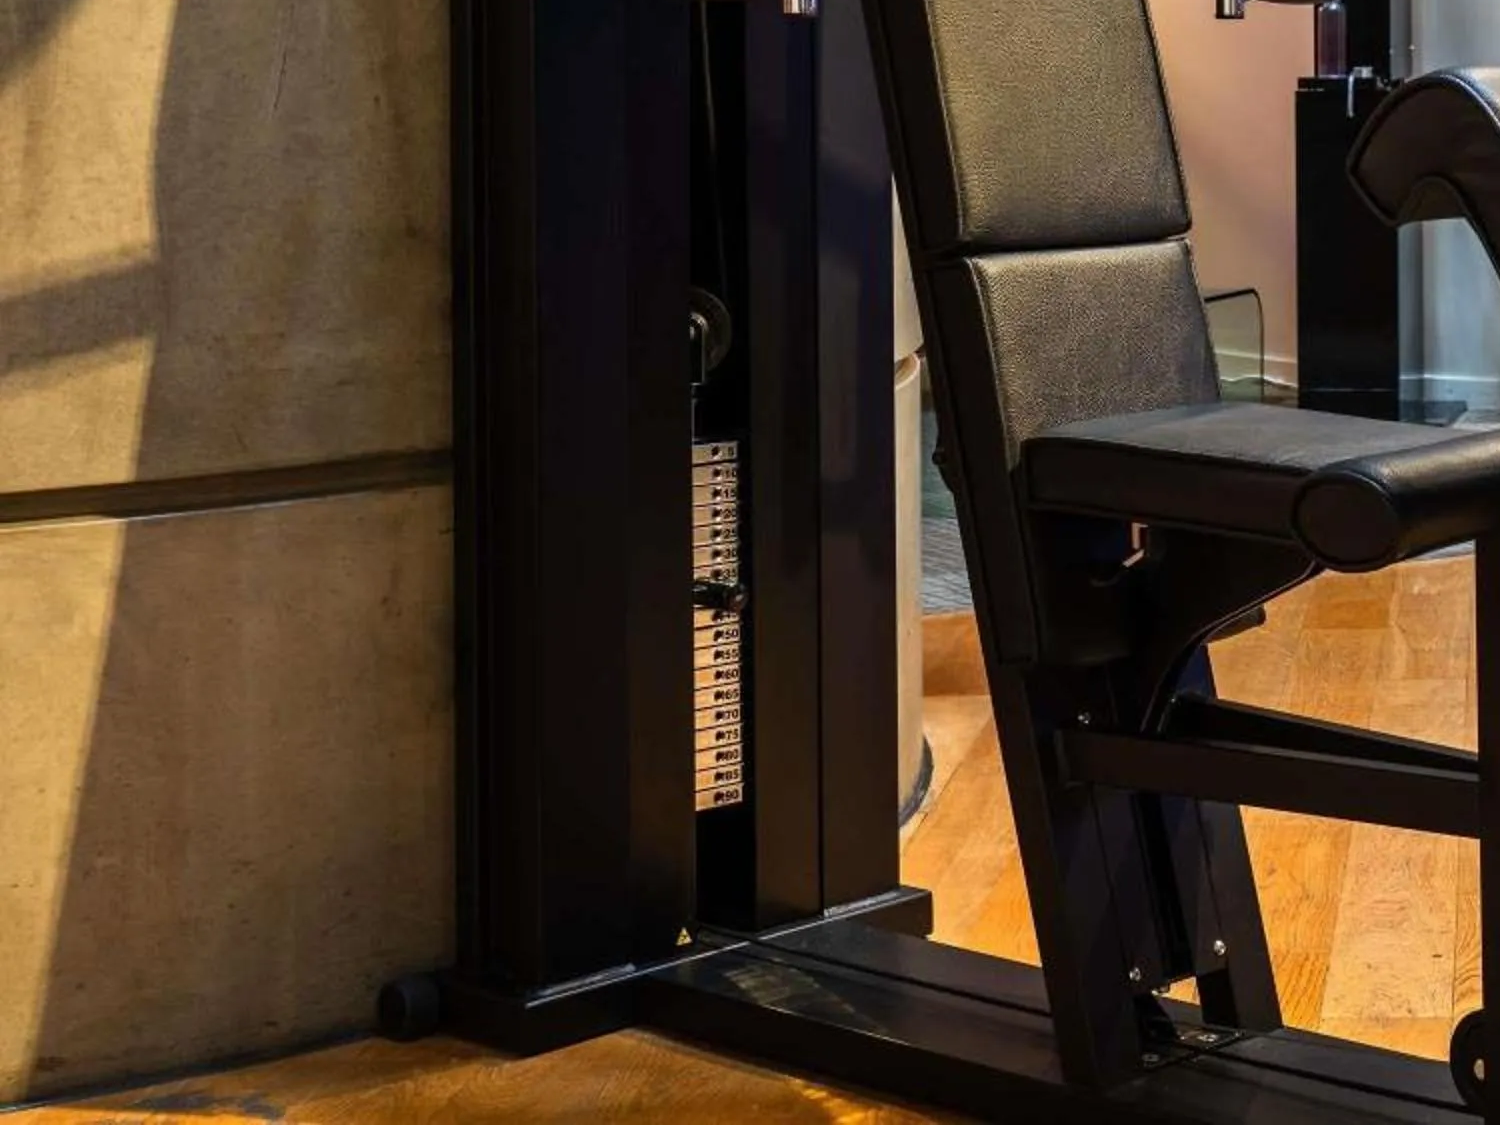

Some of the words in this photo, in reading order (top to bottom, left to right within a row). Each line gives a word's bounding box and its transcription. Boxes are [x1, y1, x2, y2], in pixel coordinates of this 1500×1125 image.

[724, 628, 739, 639] 50
[725, 708, 739, 720] 70
[725, 728, 739, 740] 75
